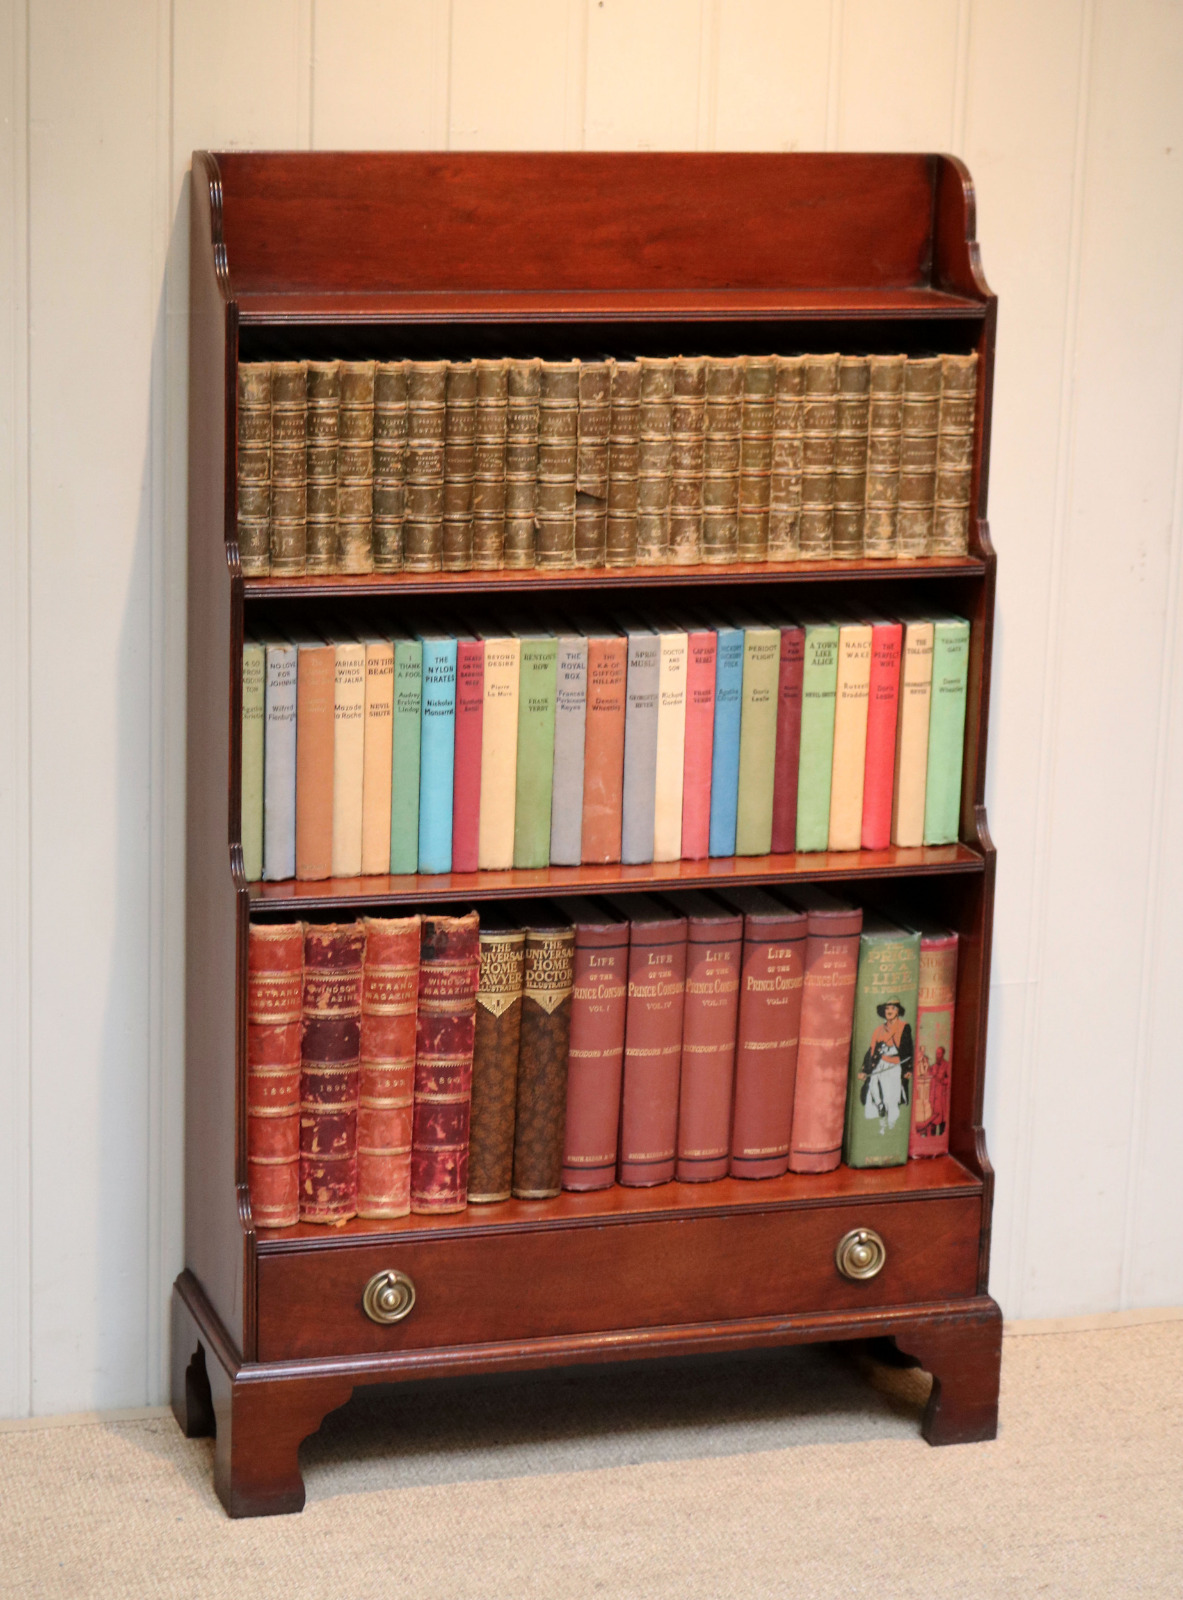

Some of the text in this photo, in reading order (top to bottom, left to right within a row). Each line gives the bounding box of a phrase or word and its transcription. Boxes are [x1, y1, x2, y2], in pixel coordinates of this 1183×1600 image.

[748, 644, 777, 652] PERIDOT
[817, 641, 838, 649] TOWN
[435, 656, 448, 664] THE
[811, 658, 834, 666] ALICE
[428, 665, 454, 674] NYLON
[561, 662, 586, 670] ROYAL
[369, 667, 394, 675] BEACH
[425, 674, 454, 683] PIRATES
[427, 699, 453, 707] Nicholas
[424, 708, 453, 716] Monsarrat
[490, 943, 511, 953] THE
[543, 940, 562, 950] THE
[479, 950, 524, 963] NIVERSAL
[867, 948, 916, 963] PRICE
[481, 960, 518, 974] HOME
[533, 958, 569, 971] HOME
[767, 964, 790, 973] OF THE
[879, 963, 908, 972] OF A
[526, 968, 573, 982] DOCTOR
[648, 970, 672, 979] OF THE
[706, 967, 729, 976] OF THE
[428, 977, 471, 986] WINDSOR
[479, 970, 523, 985] AWYER
[600, 973, 613, 981] THE
[872, 971, 912, 985] LIFE
[370, 981, 413, 990] STRAND
[479, 983, 521, 992] LLUSTRATED
[747, 976, 775, 991] PRINCE
[257, 988, 299, 997] STRAND
[424, 986, 474, 995] MAGAZINE
[365, 991, 416, 1000] MAGAZINE
